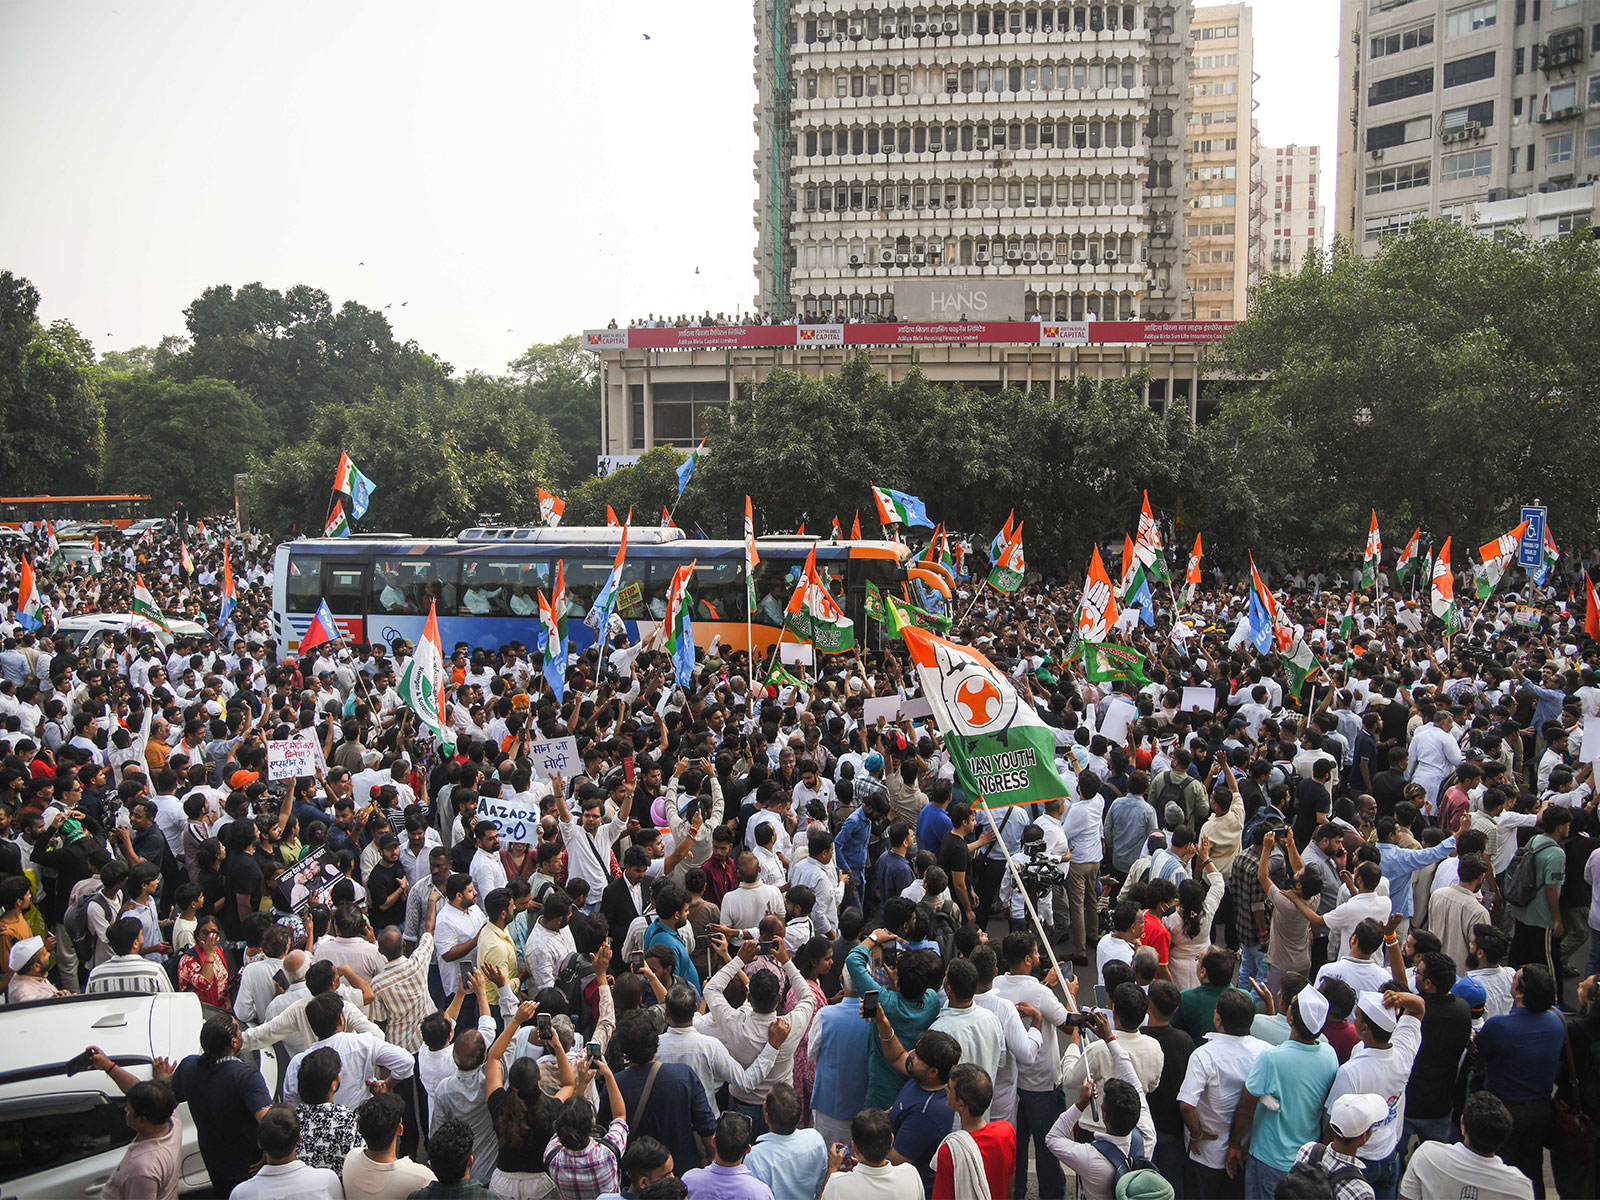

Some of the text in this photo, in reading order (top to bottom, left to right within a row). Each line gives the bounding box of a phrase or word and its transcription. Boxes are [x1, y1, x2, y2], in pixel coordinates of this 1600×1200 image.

[951, 283, 970, 291] THE
[930, 291, 988, 312] HANS
[930, 312, 951, 320] NEW
[618, 586, 636, 600] STOP
[533, 741, 568, 754] मान जा
[299, 758, 306, 766] के
[543, 753, 569, 770] मोदी
[992, 747, 1036, 772] YOUTH
[477, 798, 537, 823] AAZADI
